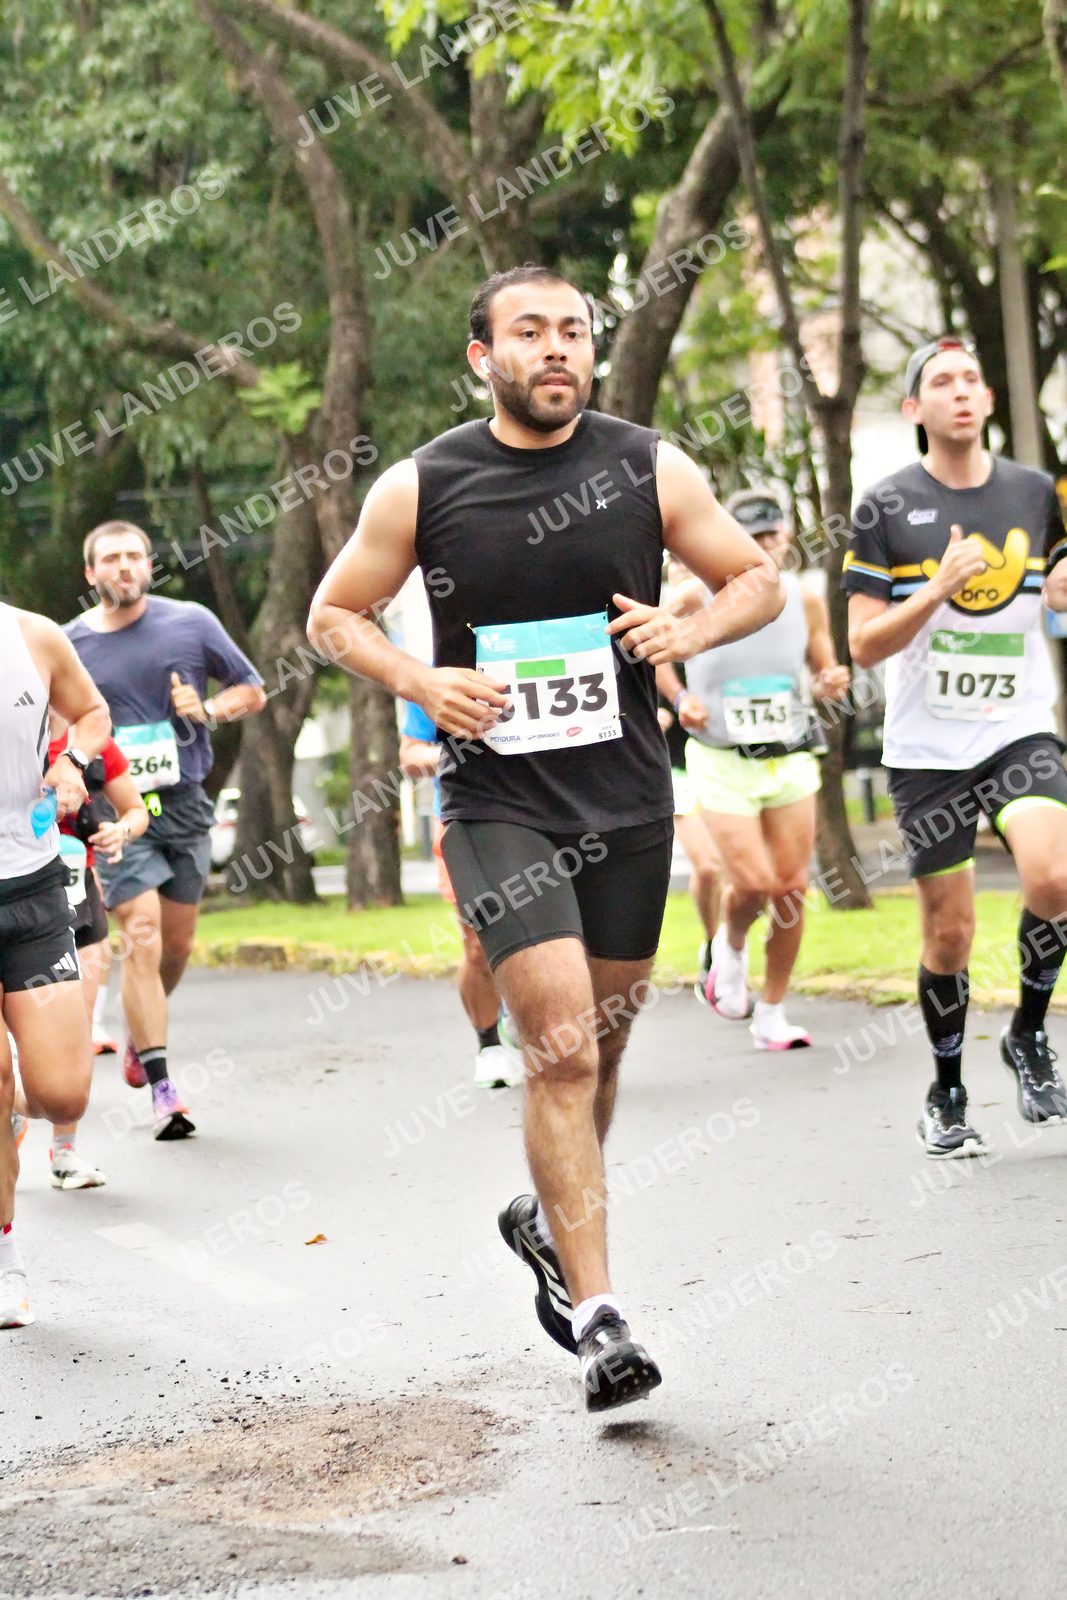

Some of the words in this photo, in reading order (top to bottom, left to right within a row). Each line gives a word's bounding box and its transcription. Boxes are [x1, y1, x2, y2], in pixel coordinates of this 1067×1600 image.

[960, 588, 999, 602] bro
[935, 669, 1016, 699] 1073
[731, 705, 787, 727] 3143
[598, 730, 617, 740] 5133
